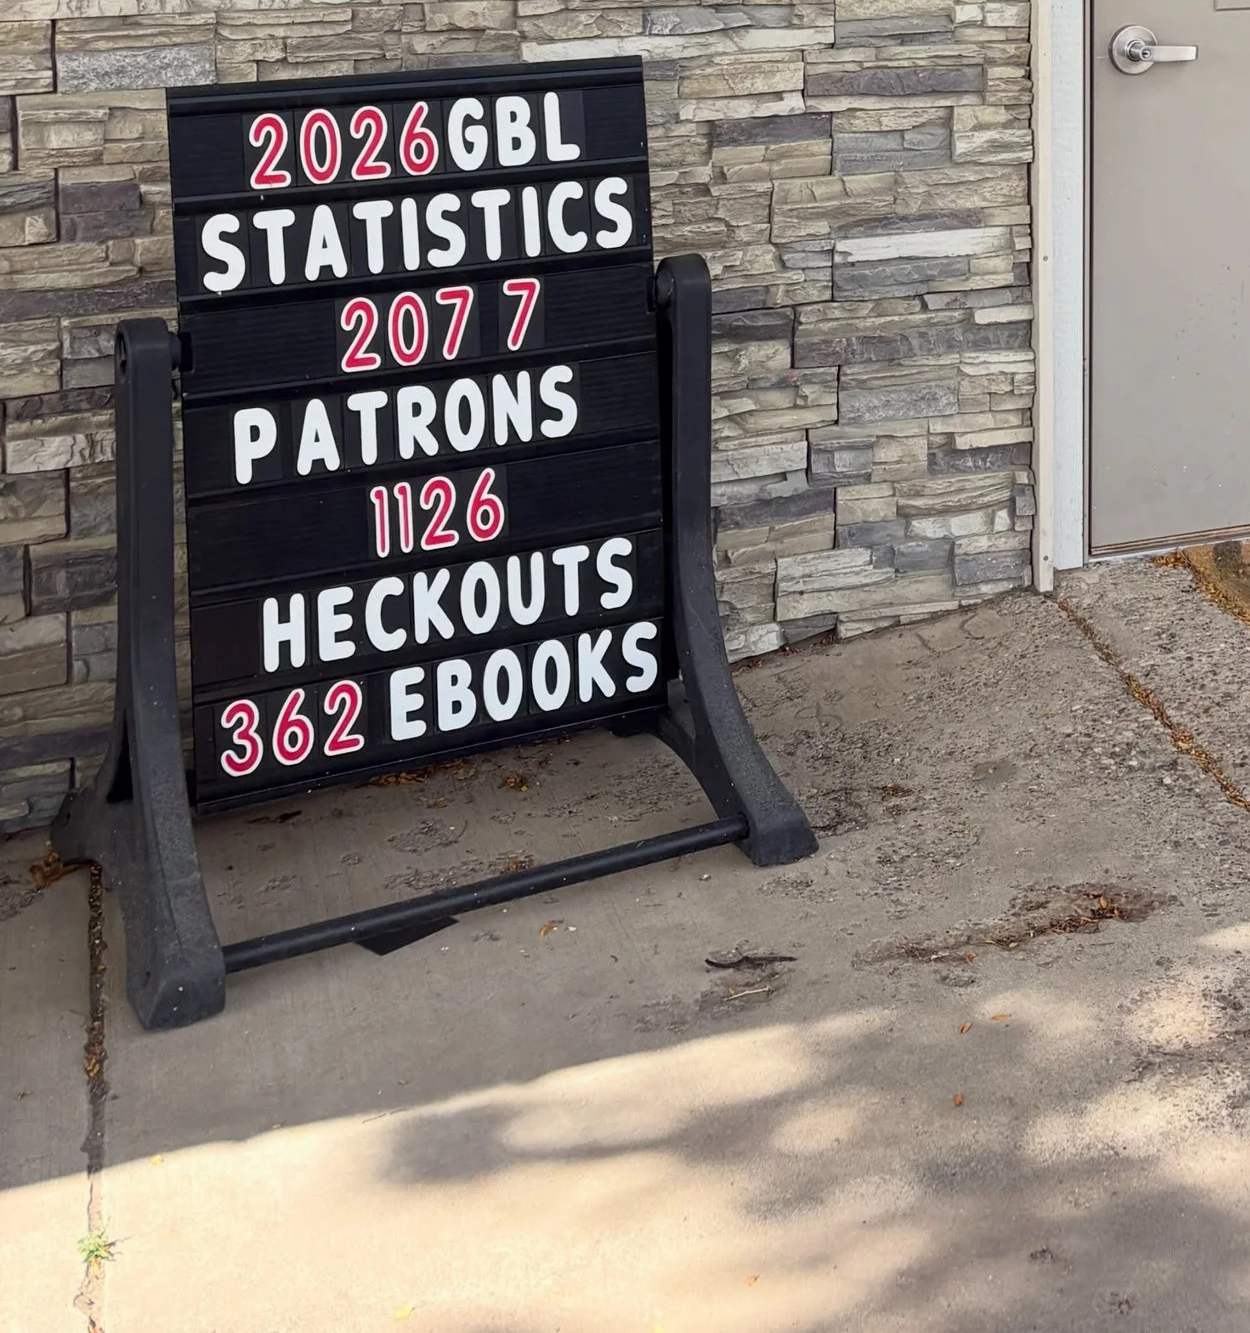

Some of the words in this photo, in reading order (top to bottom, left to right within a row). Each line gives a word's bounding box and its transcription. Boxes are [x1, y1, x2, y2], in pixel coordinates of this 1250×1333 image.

[201, 176, 634, 296] STATISTICS
[234, 364, 578, 485] PATRONS
[370, 467, 505, 558] 1126
[263, 537, 634, 673] HECKOUTS
[221, 679, 365, 777] 362
[390, 621, 658, 741] EBOOKS
